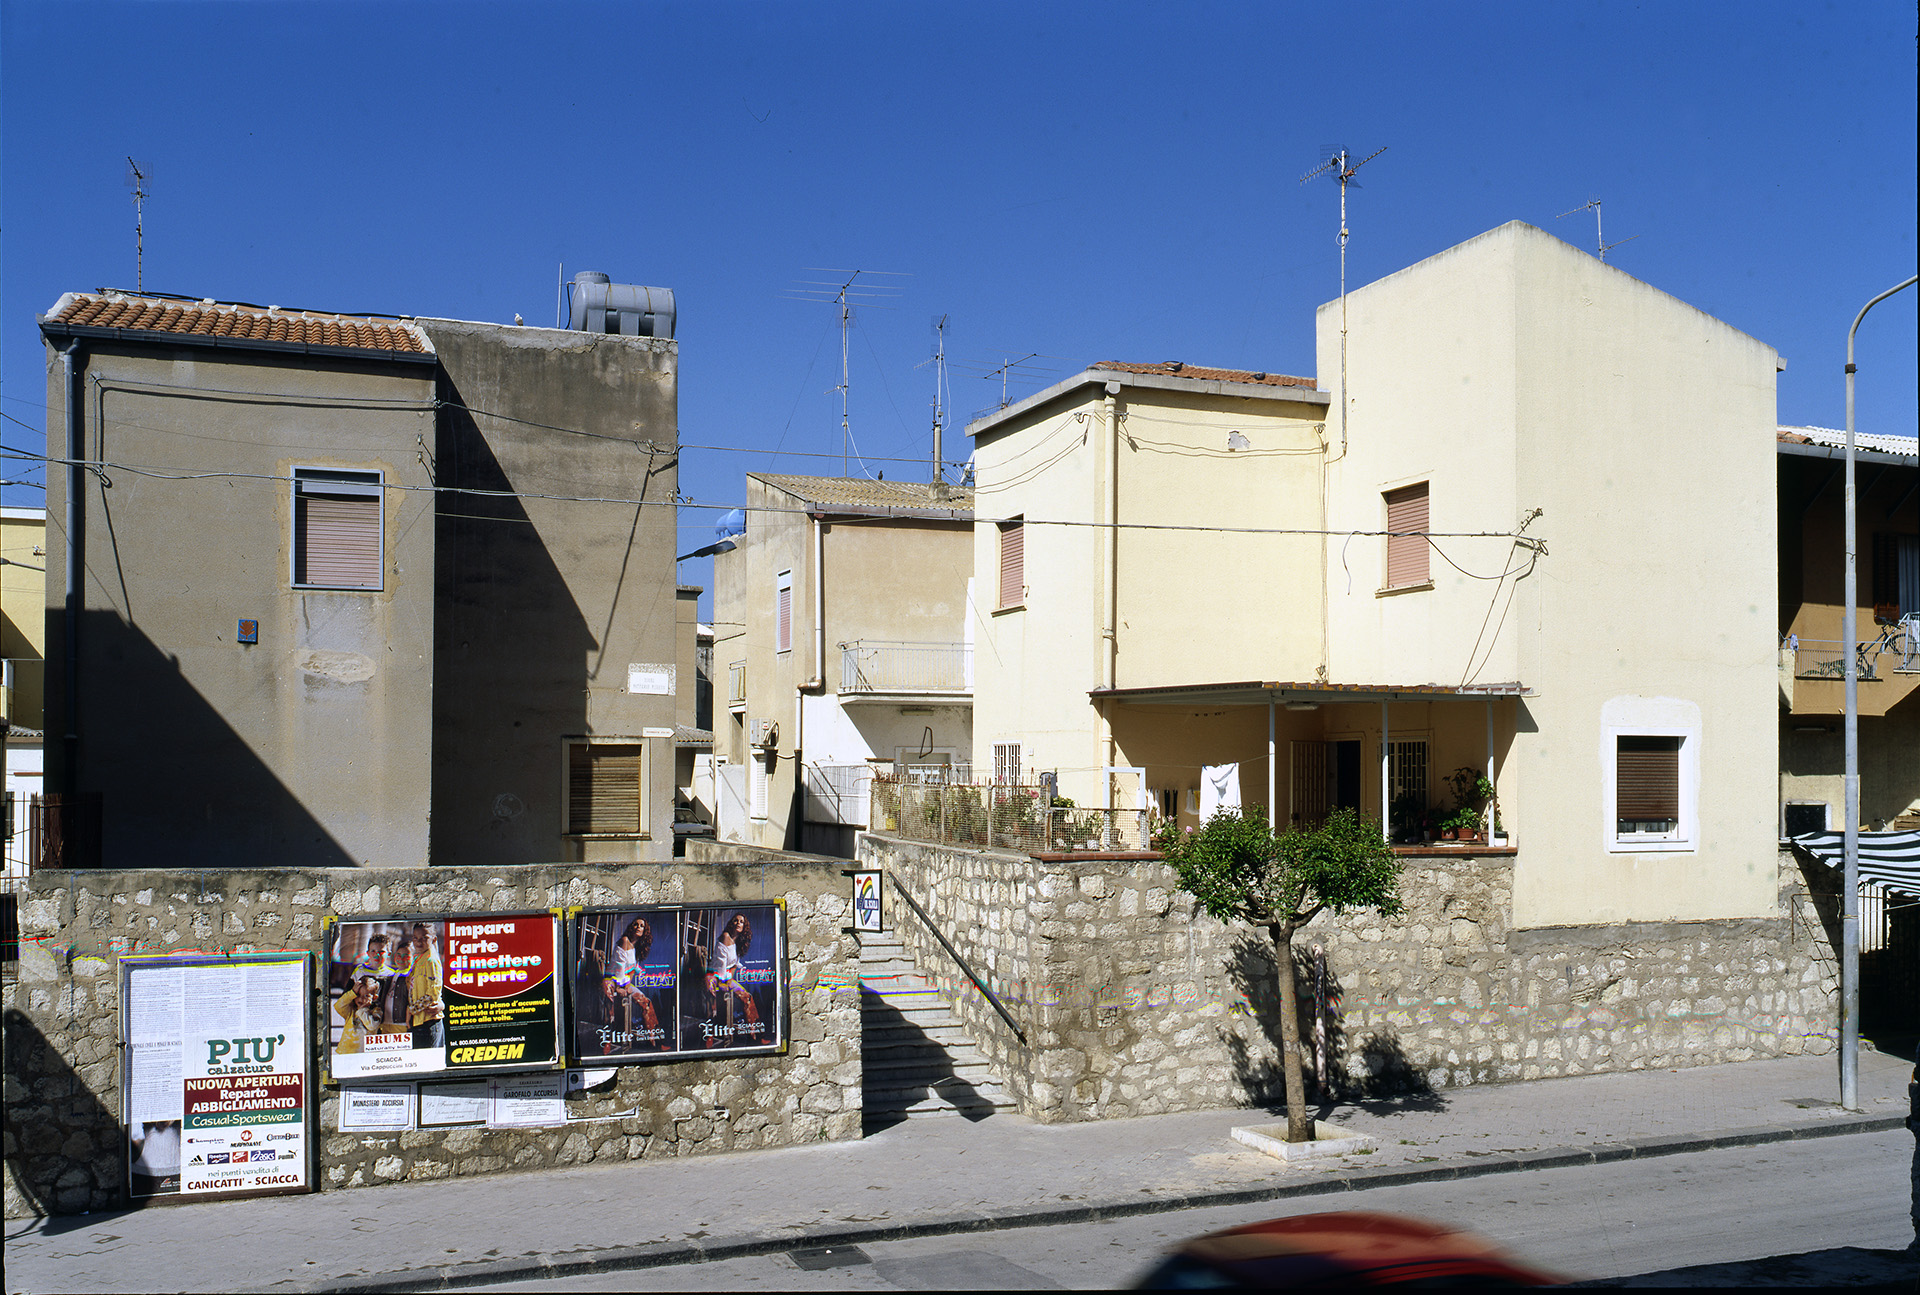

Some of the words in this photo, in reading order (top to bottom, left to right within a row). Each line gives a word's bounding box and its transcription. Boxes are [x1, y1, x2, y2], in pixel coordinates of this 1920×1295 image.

[449, 922, 515, 939] Impara
[449, 939, 499, 955] l'arte
[449, 955, 468, 970] di
[469, 954, 542, 969] mettere
[449, 969, 474, 985] da
[477, 968, 528, 987] parte
[449, 1003, 477, 1012] Domino
[489, 1001, 510, 1010] piano
[449, 1010, 462, 1018] che
[469, 1009, 488, 1017] aiuta
[495, 1006, 536, 1016] risparmiare
[365, 1033, 411, 1045] BRUMS
[450, 1043, 526, 1064] CREDEM
[207, 1064, 274, 1075] calzature
[187, 1078, 232, 1091] NUOVA
[234, 1075, 300, 1088] APERTURA
[220, 1087, 268, 1101] Reparto
[533, 1089, 559, 1097] ACCURSIA
[191, 1097, 296, 1114] ABBIGLIAMENTO
[192, 1113, 295, 1127] Casual-Sportswear
[242, 1166, 271, 1175] vendita
[255, 1174, 299, 1186] SCIACCA
